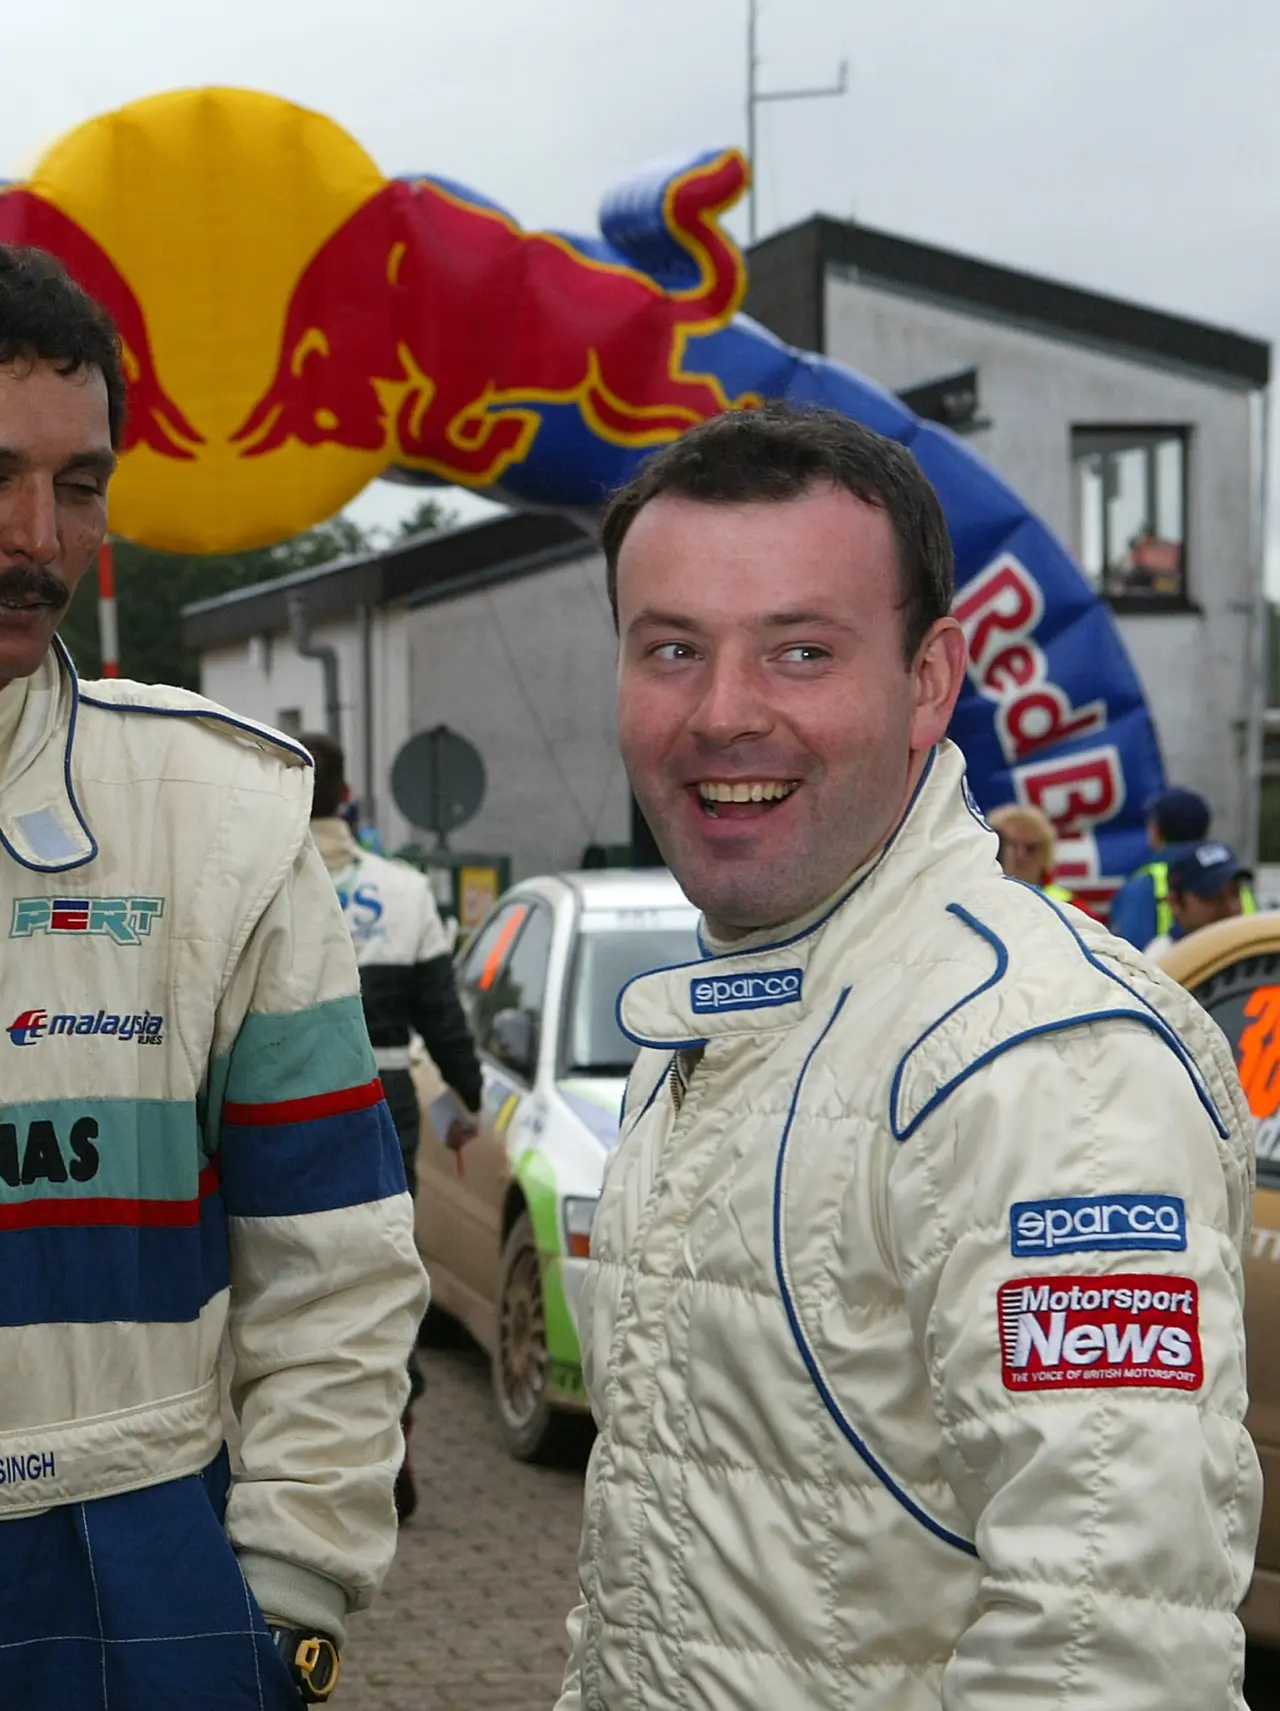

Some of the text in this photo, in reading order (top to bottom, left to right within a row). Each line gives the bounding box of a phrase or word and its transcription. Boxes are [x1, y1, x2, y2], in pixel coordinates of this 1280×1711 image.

[948, 552, 1107, 765] Red
[9, 895, 165, 946] PERT
[695, 975, 799, 1007] sparco
[48, 1009, 164, 1041] malaysia
[1016, 1204, 1180, 1248] sparco
[1021, 1285, 1194, 1315] Motorsport
[1013, 1312, 1193, 1368] News
[1032, 1370, 1064, 1381] VOICE
[1066, 1370, 1081, 1380] OF
[1082, 1370, 1121, 1380] BRITISH
[1123, 1370, 1196, 1382] MOTORSPORT
